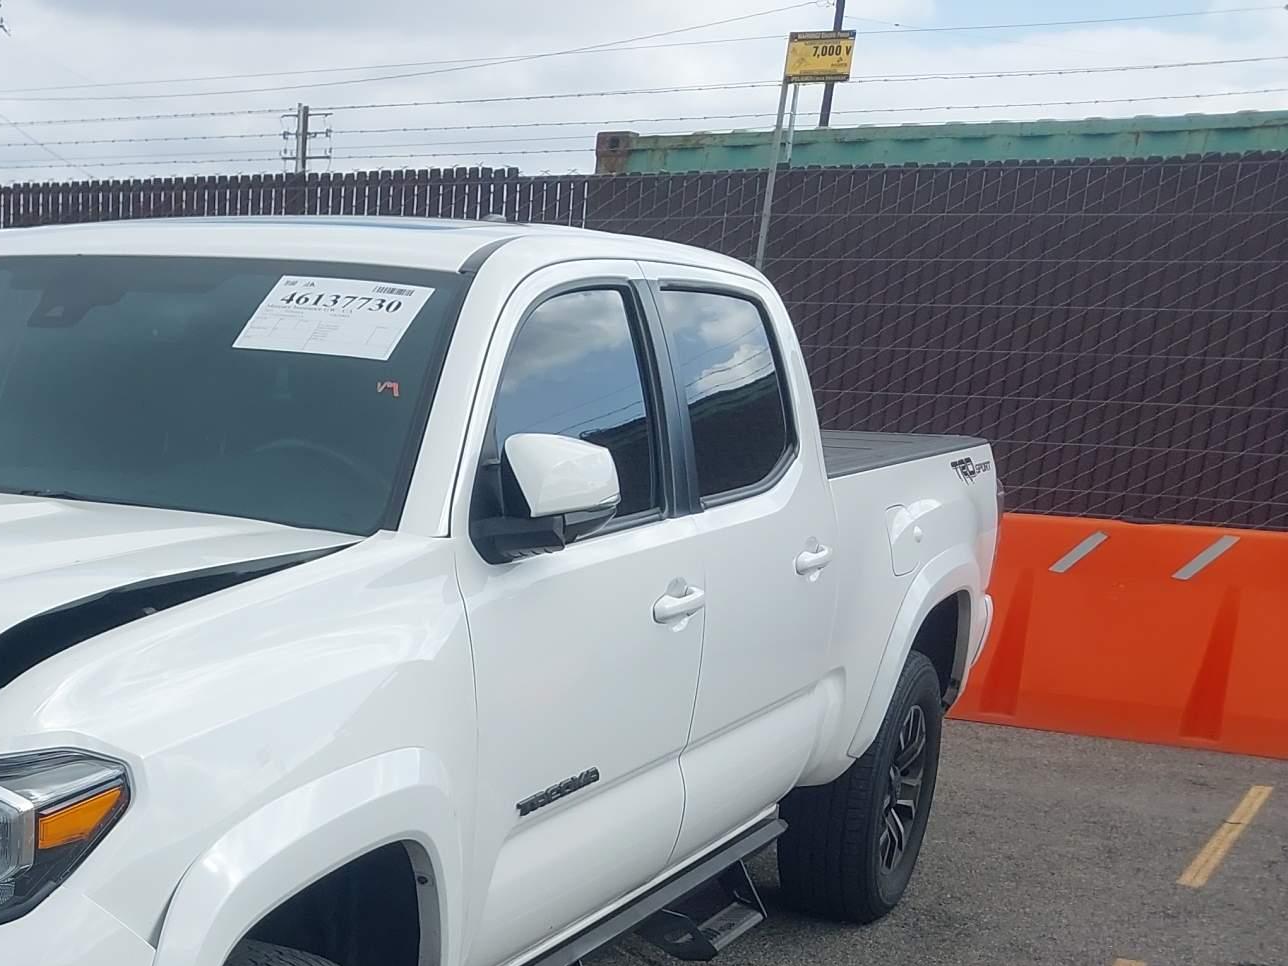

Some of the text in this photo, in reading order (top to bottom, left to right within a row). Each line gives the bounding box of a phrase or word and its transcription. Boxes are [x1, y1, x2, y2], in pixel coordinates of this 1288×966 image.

[812, 45, 852, 58] 7,000 V
[280, 291, 403, 314] 46137730
